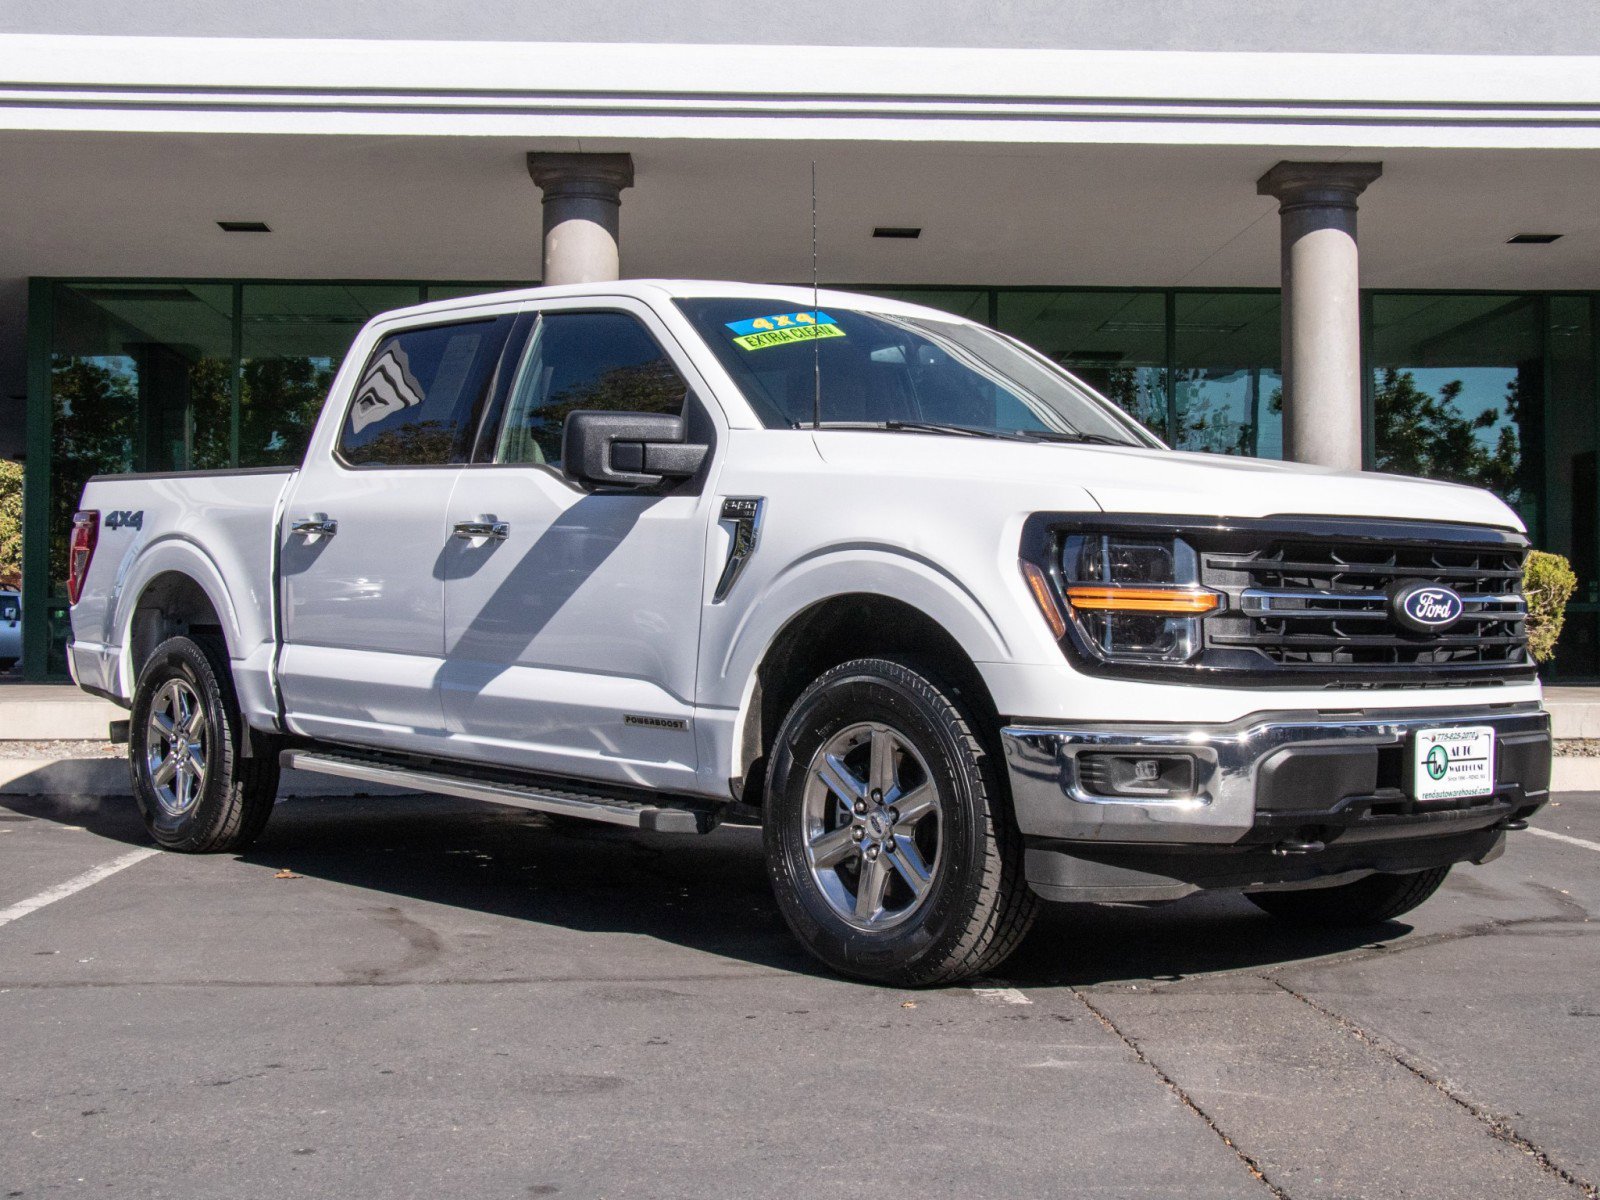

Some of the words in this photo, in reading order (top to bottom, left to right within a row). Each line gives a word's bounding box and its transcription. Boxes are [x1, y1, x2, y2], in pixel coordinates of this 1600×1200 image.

[744, 331, 790, 347] EXTRA
[790, 325, 834, 339] CLEAN
[1416, 593, 1452, 617] Ford
[625, 716, 684, 729] POWERBOOST
